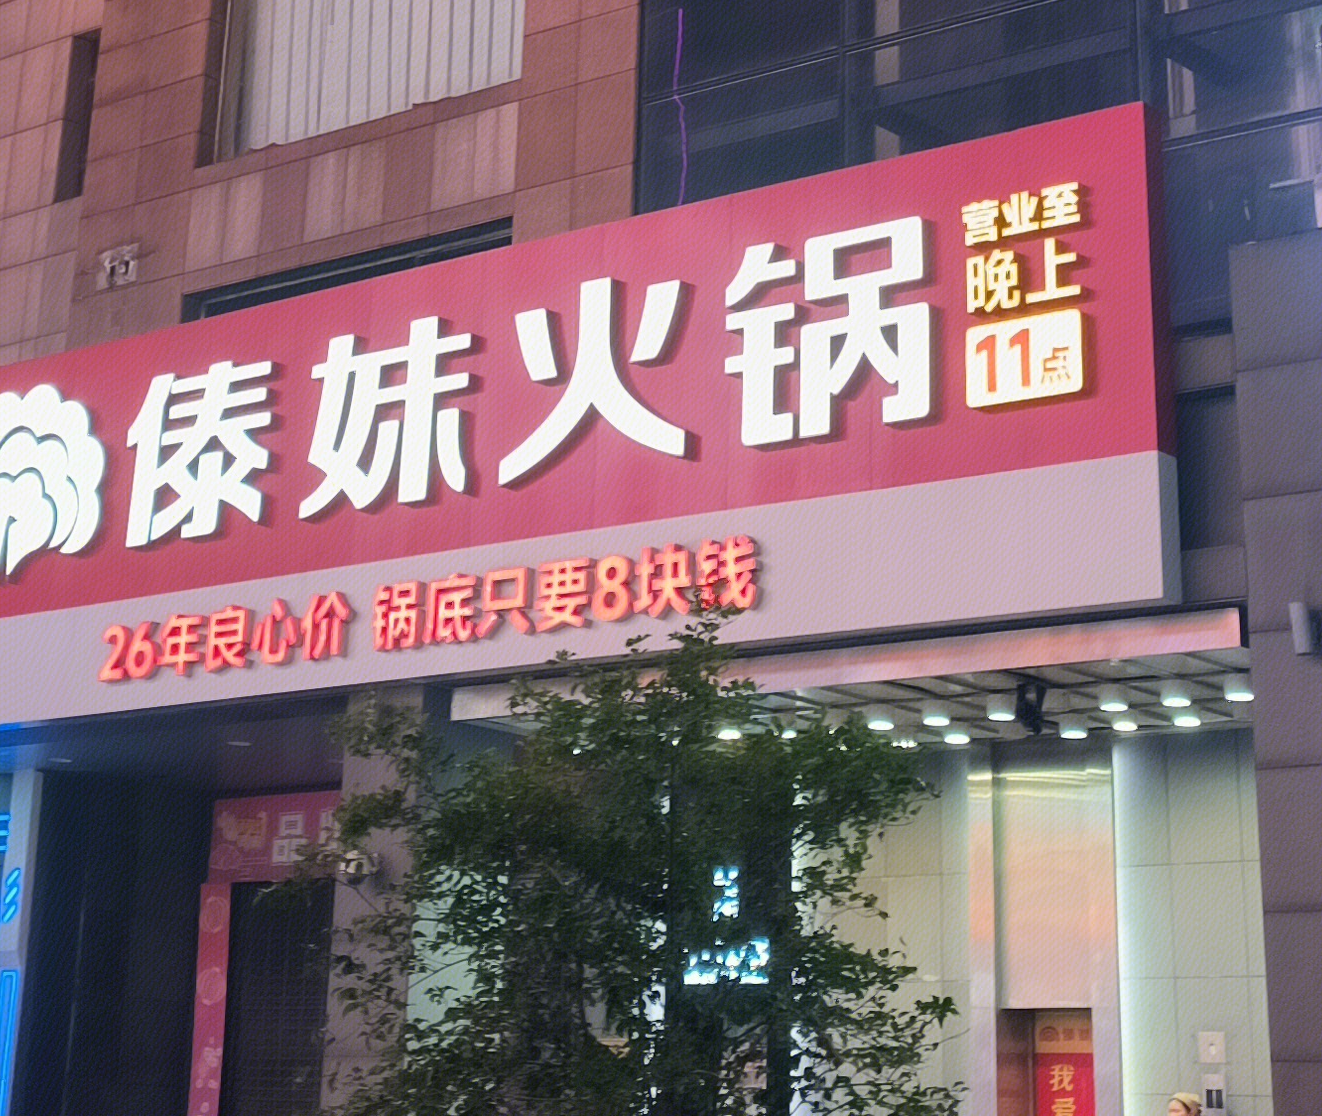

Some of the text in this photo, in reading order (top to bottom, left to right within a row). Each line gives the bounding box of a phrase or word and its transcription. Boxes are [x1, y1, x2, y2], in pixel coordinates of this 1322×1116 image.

[961, 180, 1082, 247] 营业至
[965, 237, 1082, 314] 晚上
[125, 214, 931, 548] 傣妹火锅
[974, 326, 1073, 395] 11点
[96, 533, 758, 684] 26年良心价 锅底只要8块钱
